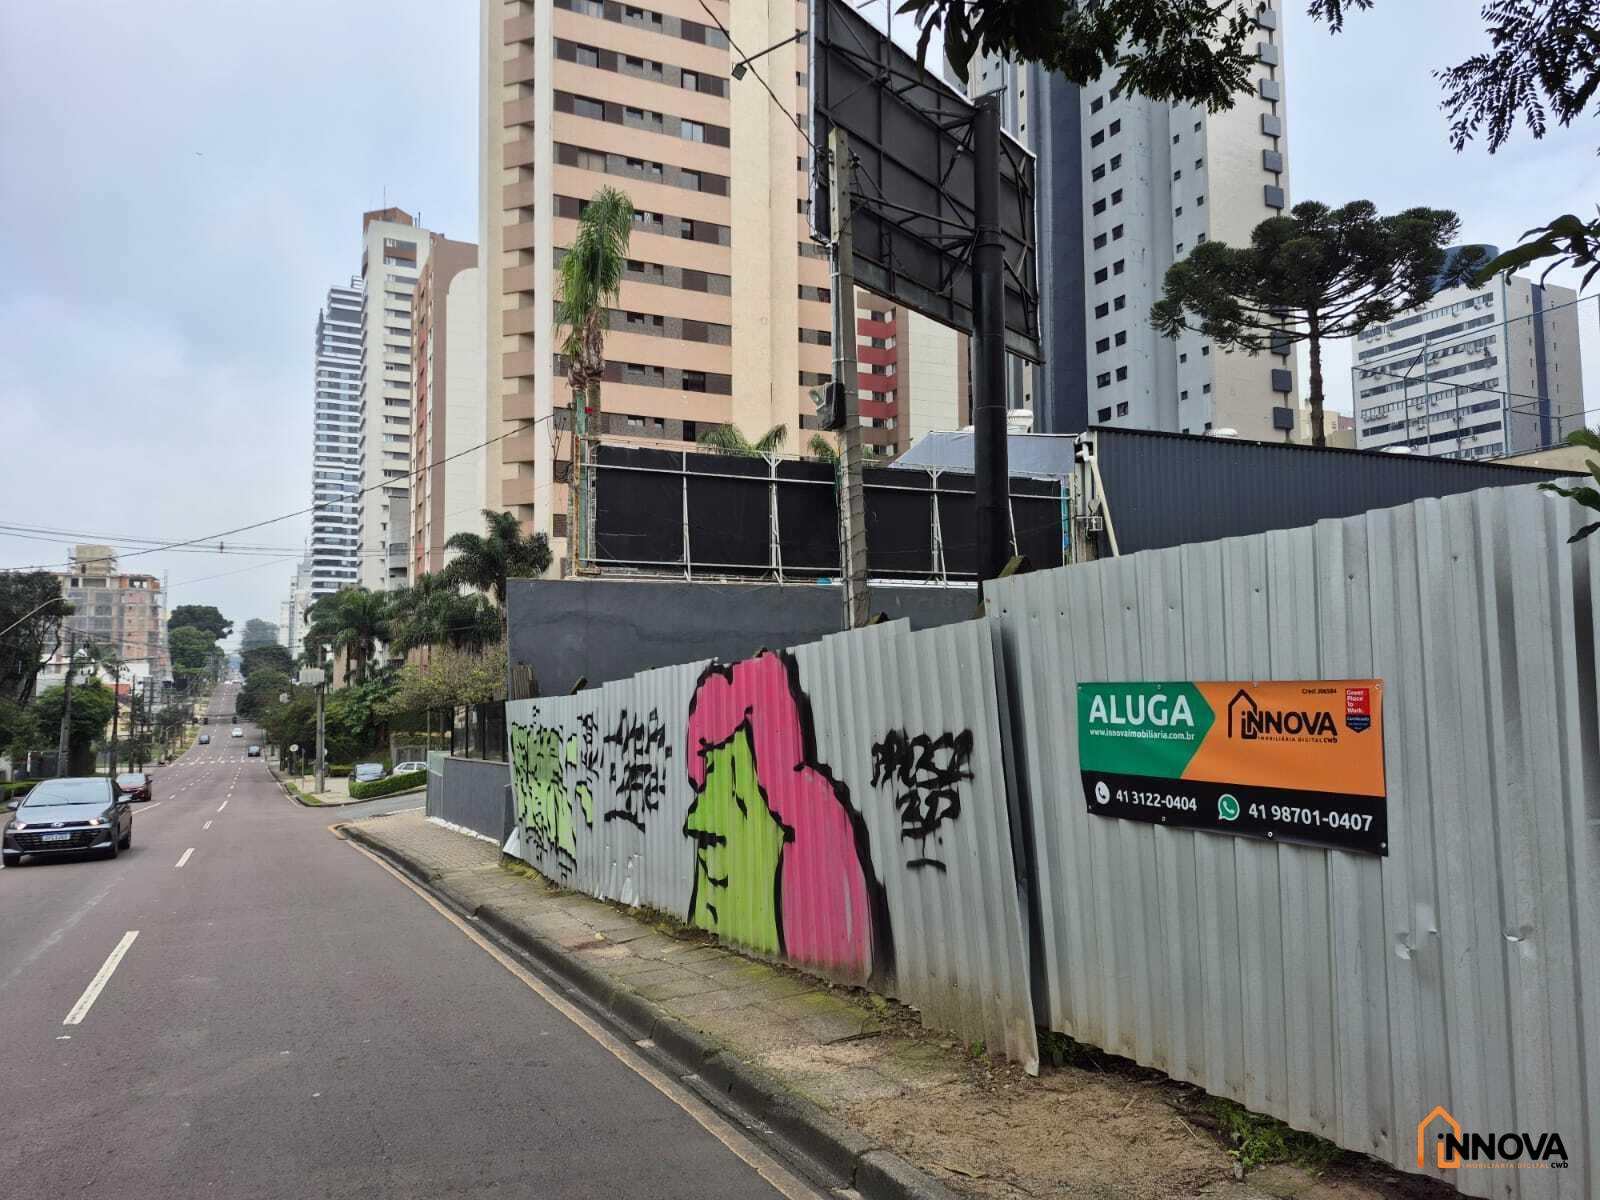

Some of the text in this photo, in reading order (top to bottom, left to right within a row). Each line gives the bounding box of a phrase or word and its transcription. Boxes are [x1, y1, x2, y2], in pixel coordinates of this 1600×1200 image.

[1089, 694, 1194, 726] ALUGA
[1089, 728, 1195, 740] www.innovaimobiliaria.com.br
[1116, 789, 1197, 812] 41 3122-0404
[1248, 803, 1373, 832] 41 98701-0407
